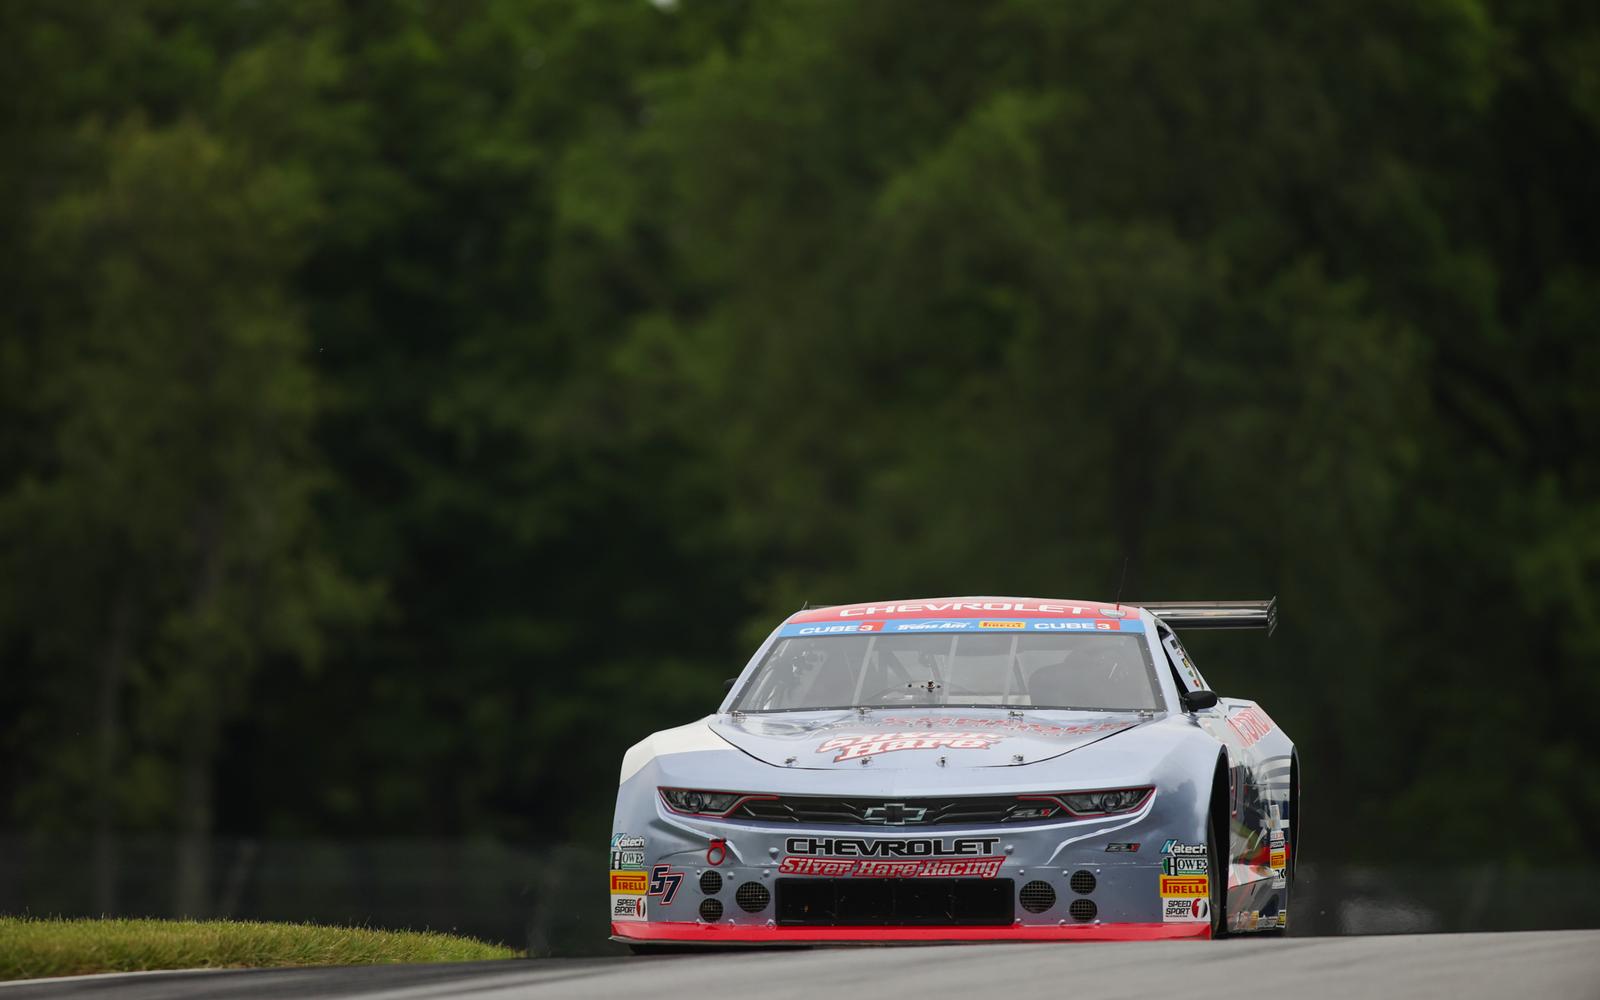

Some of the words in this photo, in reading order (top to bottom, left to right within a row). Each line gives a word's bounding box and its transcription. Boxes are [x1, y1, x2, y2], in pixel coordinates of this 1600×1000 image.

[840, 601, 1091, 617] CHEVROLET
[981, 621, 1024, 629] PIRELLI
[611, 832, 645, 851] Katech
[785, 837, 1000, 856] CHEVROLET
[1161, 839, 1208, 857] Katech
[779, 856, 854, 878] Silver
[852, 860, 921, 878] Hare
[917, 856, 1006, 879] Racing
[611, 875, 647, 890] PIRELLI
[648, 864, 685, 905] 57
[1162, 878, 1207, 894] PIRELLI
[616, 899, 636, 907] SPEED
